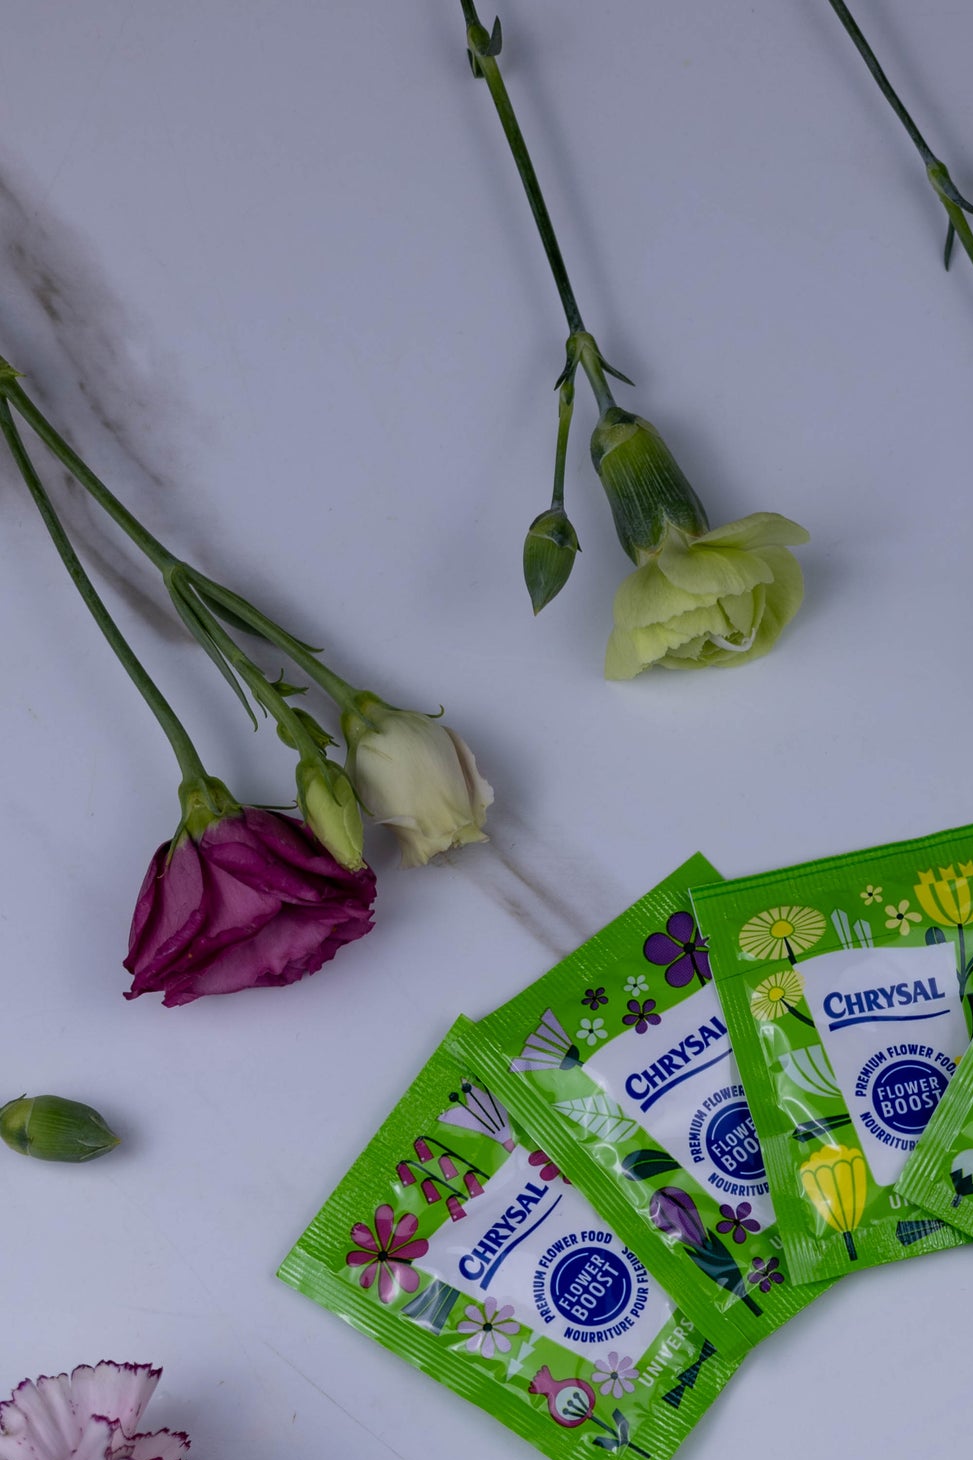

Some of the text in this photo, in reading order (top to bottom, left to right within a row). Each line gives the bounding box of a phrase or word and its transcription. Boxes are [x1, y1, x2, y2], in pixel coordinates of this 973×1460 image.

[823, 977, 946, 1019] CHRYSAL
[855, 1051, 887, 1097] PREMIUM
[887, 1044, 934, 1059] FLOWER
[877, 1076, 940, 1101] FLOWER
[880, 1089, 941, 1118] BOOST
[688, 1109, 708, 1163] PREMIUM
[711, 1117, 756, 1157] FLOWE
[859, 1111, 919, 1152] NOURRITUR
[707, 1172, 770, 1197] NOURRITUR
[459, 1182, 550, 1281] CHRYSAL
[532, 1230, 613, 1324] PREMIUM FLOWER FOOD
[558, 1254, 606, 1310] FLOWER
[570, 1261, 620, 1321] BOOST
[563, 1316, 635, 1343] NOURRITURE
[630, 1286, 649, 1319] POUR
[640, 1317, 695, 1387] UNIVERS
